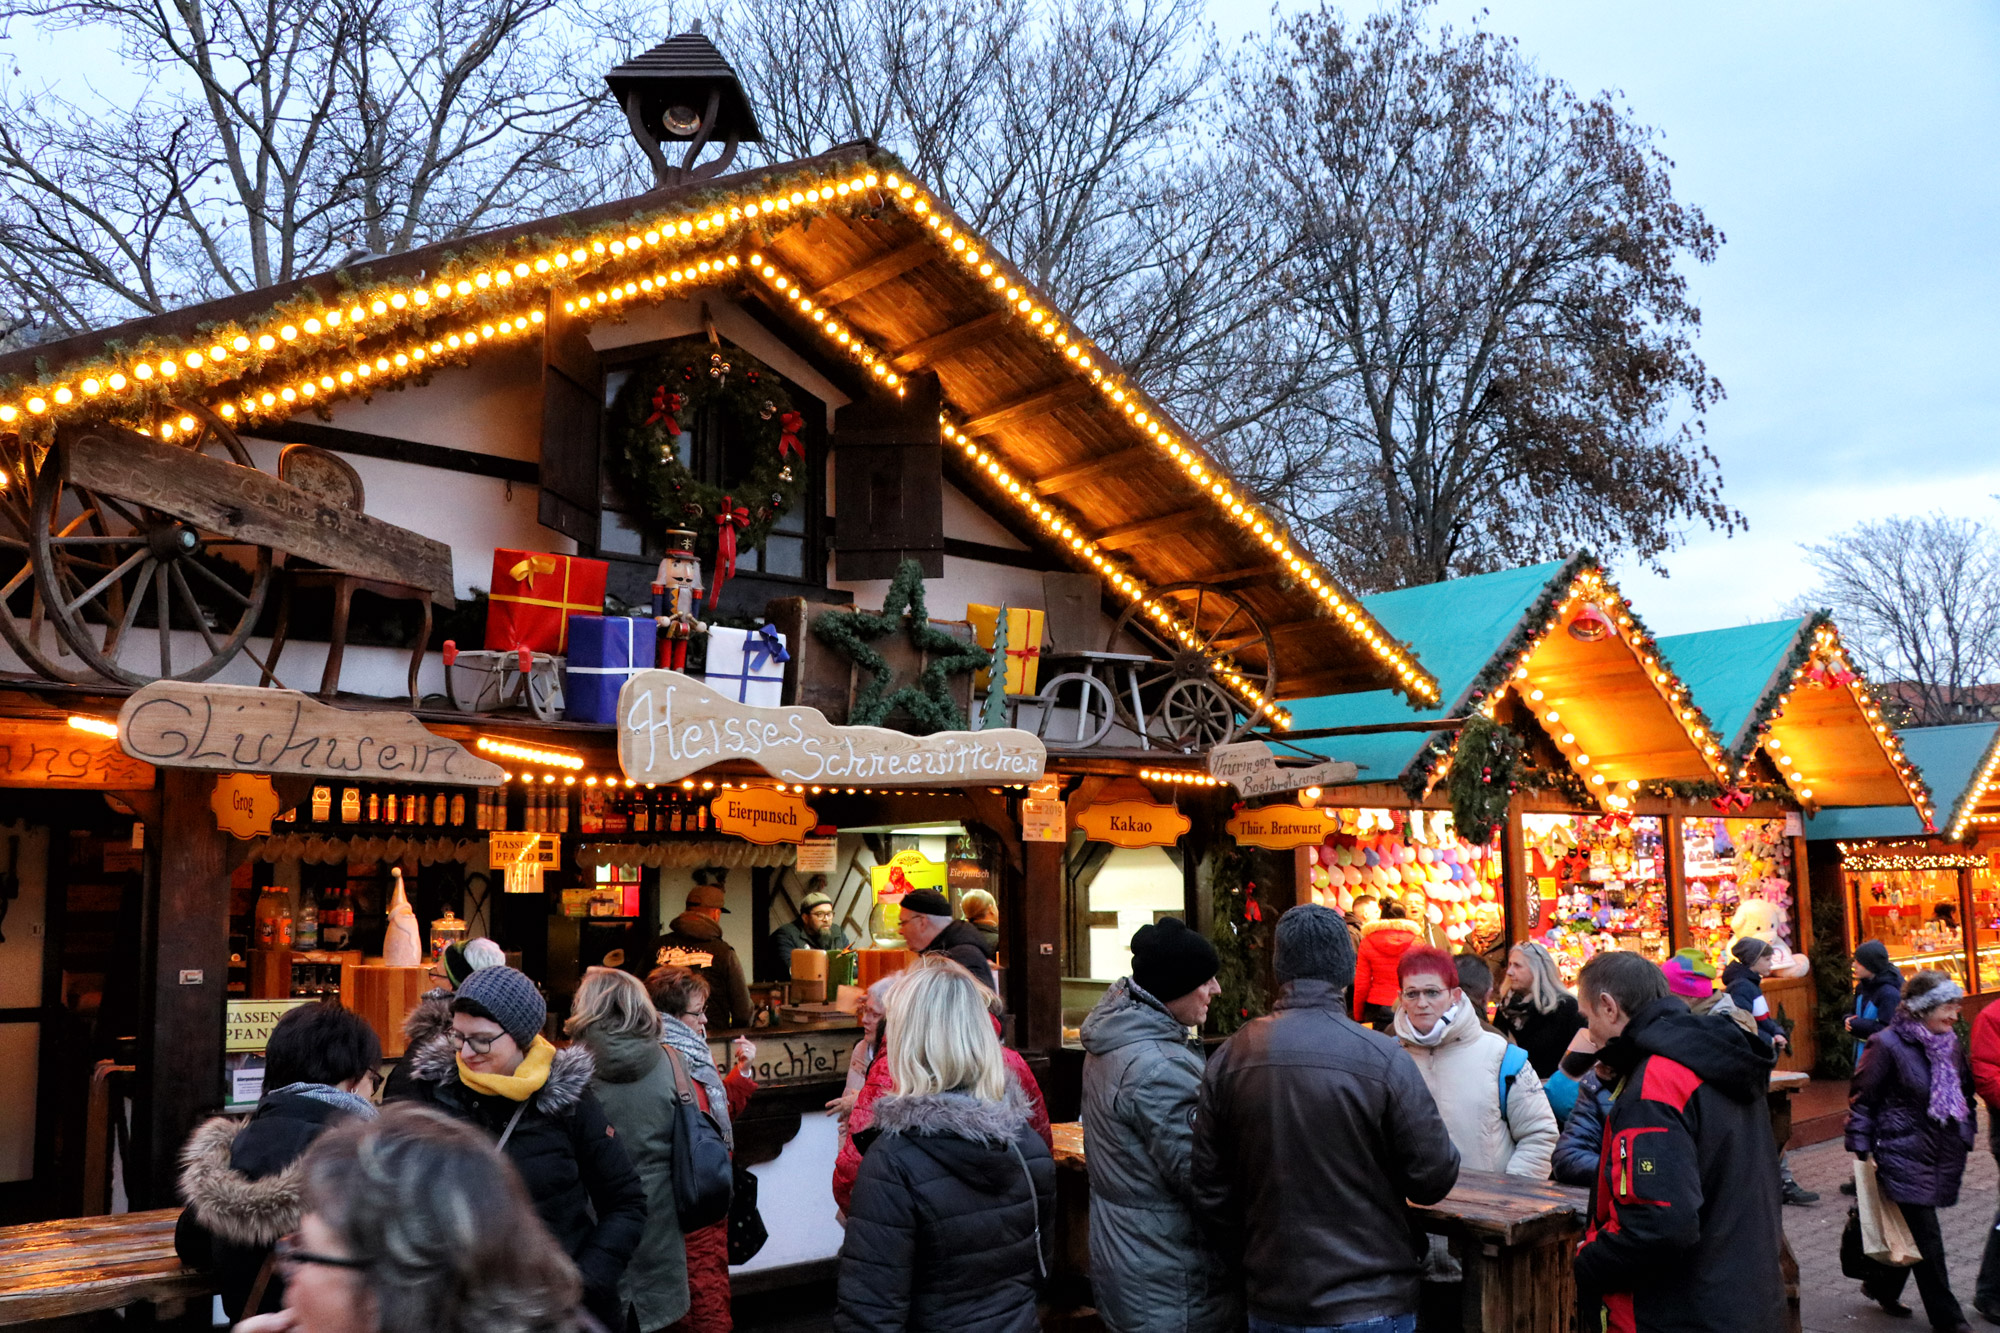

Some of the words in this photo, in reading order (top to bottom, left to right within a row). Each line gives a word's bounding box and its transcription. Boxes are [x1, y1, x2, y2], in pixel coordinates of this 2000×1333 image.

[627, 685, 803, 772] Heisses
[781, 738, 1039, 781] Schneewittchen
[1212, 753, 1271, 776] Thüringer
[1242, 770, 1328, 795] Rostbratwurst
[232, 789, 254, 819] Grog
[1044, 804, 1063, 817] 2019
[727, 800, 798, 828] Eierpunsch
[1110, 816, 1153, 833] Kakao
[1239, 821, 1267, 836] Thür.
[1271, 821, 1322, 835] Bratwurst
[495, 840, 535, 850] TASSE
[949, 867, 990, 880] Eierpunsch
[227, 1010, 281, 1024] TASSEN
[227, 1027, 274, 1040] PFAN
